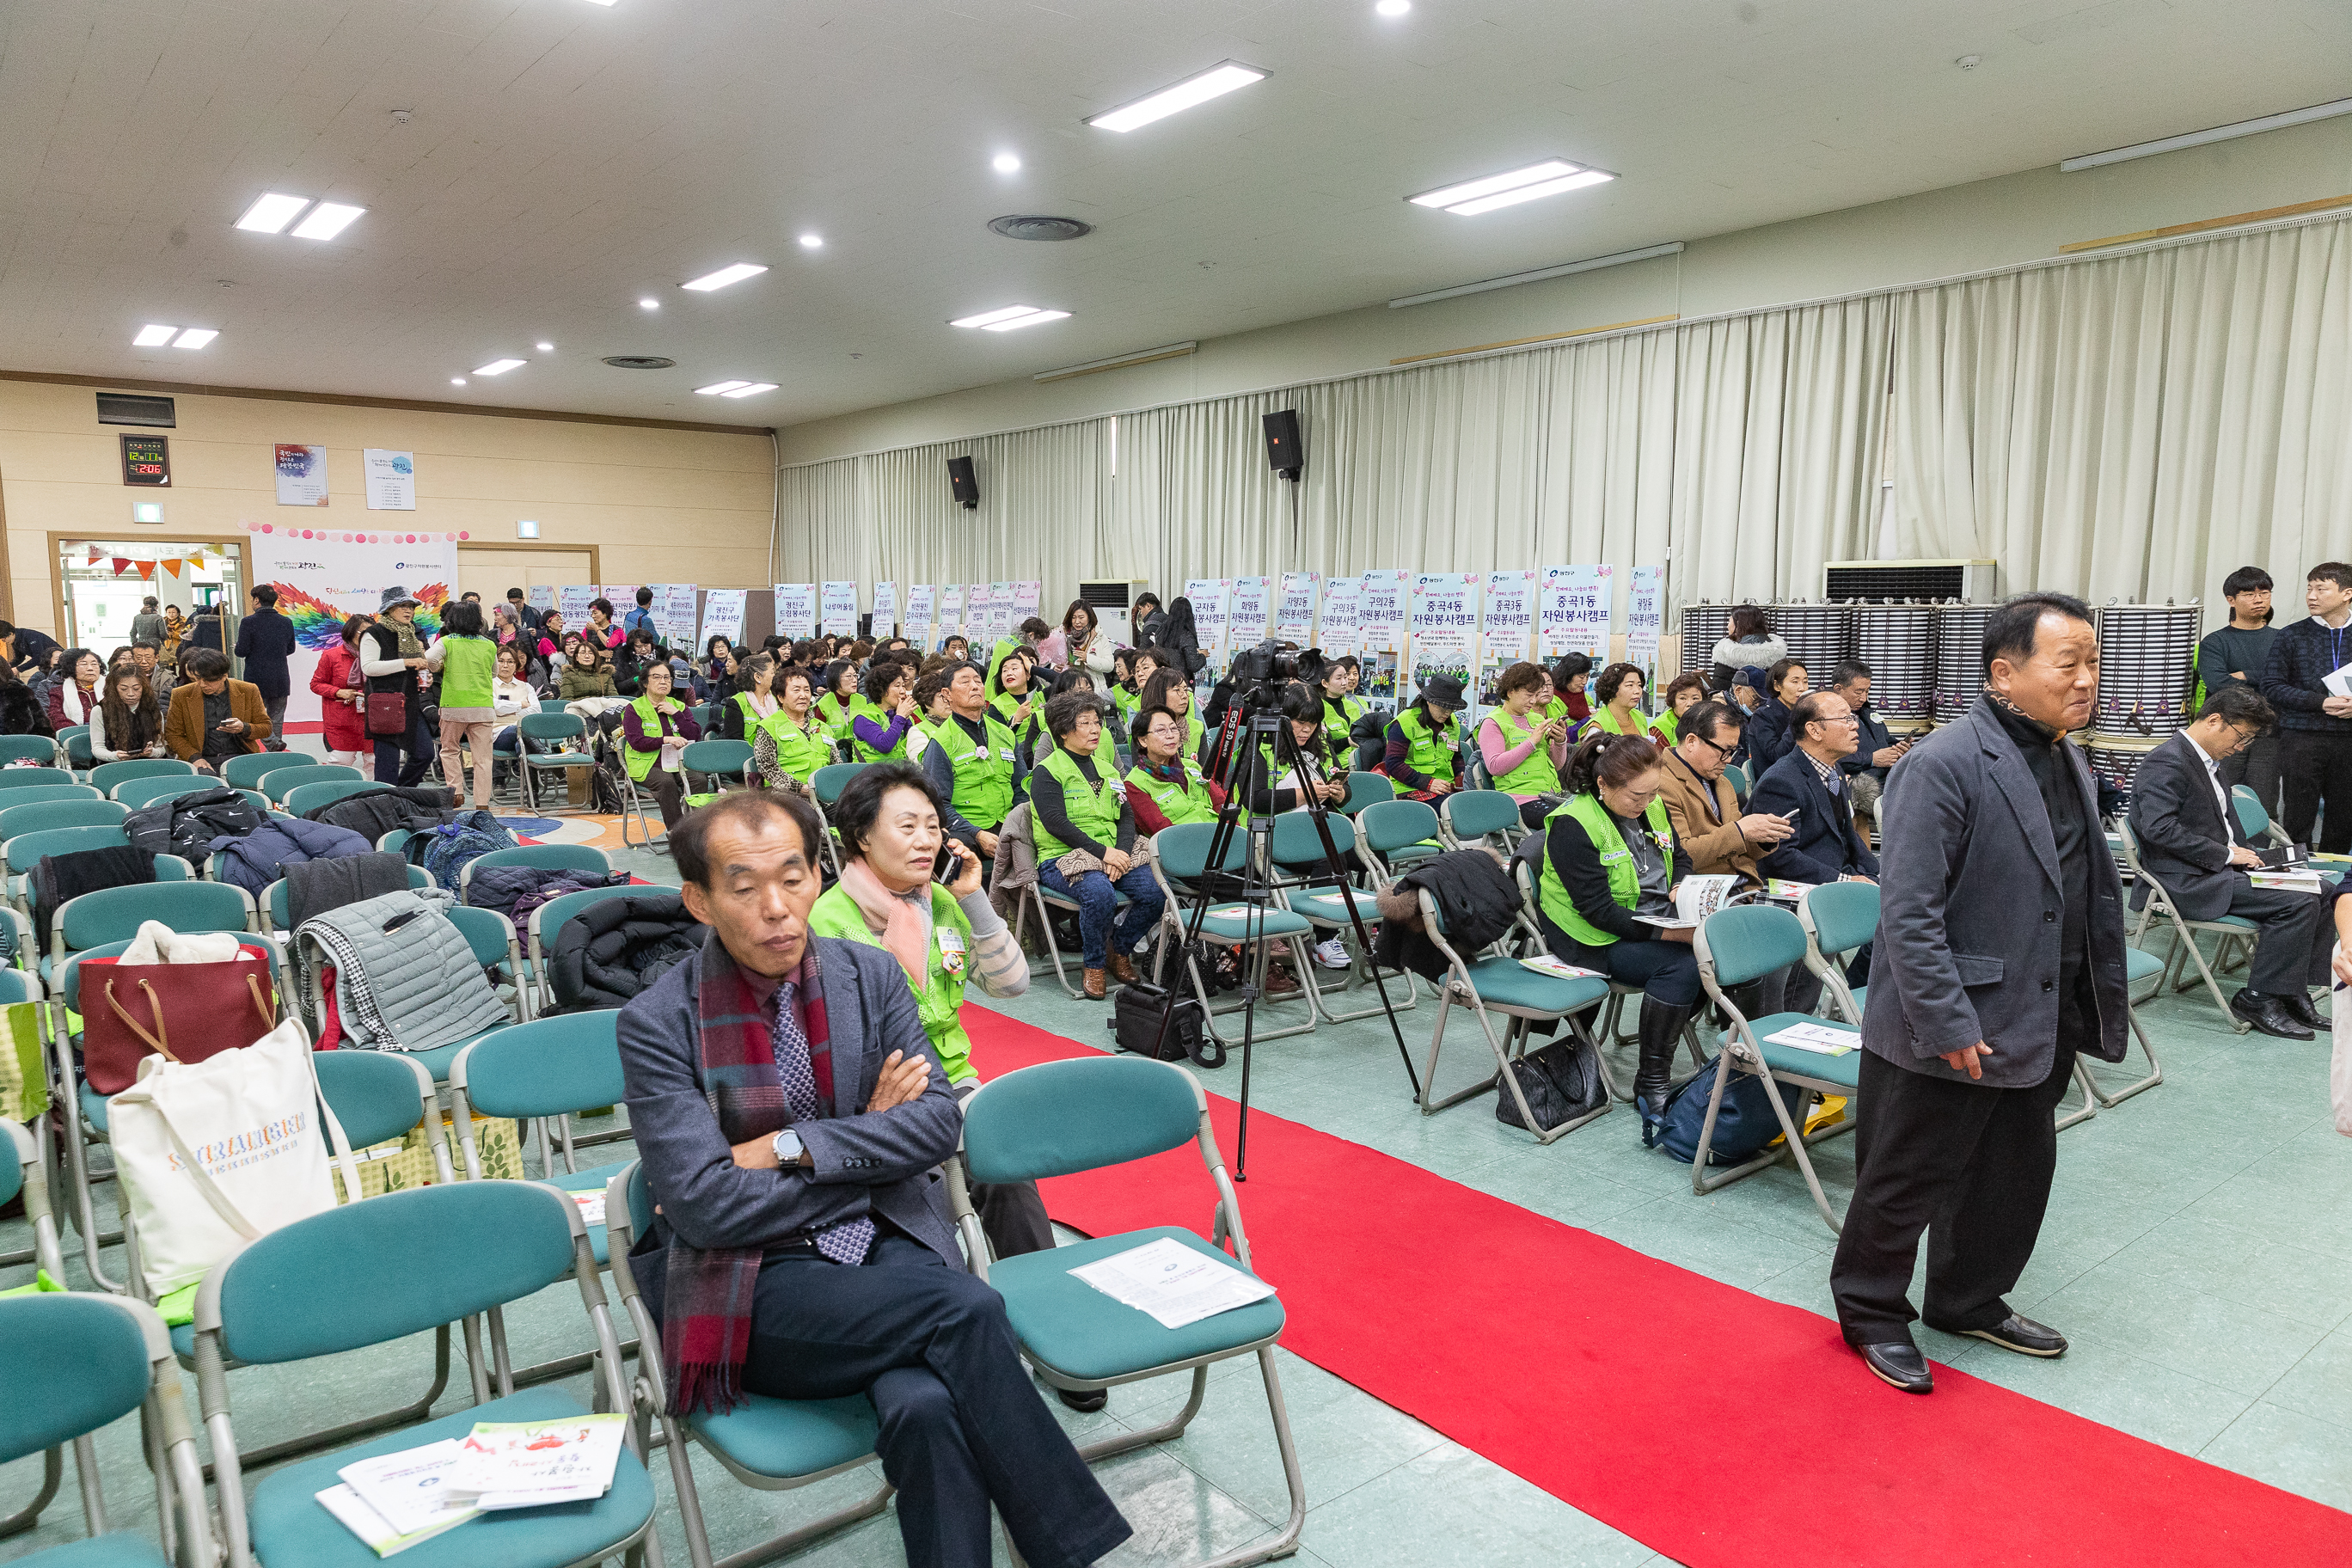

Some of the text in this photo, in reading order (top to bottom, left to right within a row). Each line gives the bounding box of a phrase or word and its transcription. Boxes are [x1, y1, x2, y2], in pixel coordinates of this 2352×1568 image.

[129, 452, 138, 461] 12
[138, 464, 162, 474] 2:06
[298, 561, 318, 570] 광진
[825, 603, 854, 611] 나루어울림
[1241, 601, 1259, 611] 화양동
[1287, 597, 1308, 607] 자양2동
[1369, 597, 1396, 608] 구의2동
[1426, 600, 1463, 612] 중곡4동
[1496, 599, 1522, 611] 중곡3동
[1556, 595, 1596, 608] 중곡1동
[1637, 597, 1653, 610] 광장동
[1195, 603, 1216, 612] 군자동
[1332, 603, 1357, 614] 구의3동
[1193, 613, 1226, 623] 원봉사캠프
[1232, 612, 1266, 623] 자원봉사캠프
[1278, 609, 1313, 619] 자원봉사캠프
[1358, 609, 1404, 621] 자원봉사캠프
[1485, 614, 1530, 625] 자원봉사캠프
[1542, 609, 1609, 622] 자원봉사캠프
[1628, 613, 1659, 626] 자원봉사캠프
[1321, 616, 1357, 627] 자원봉사캠
[1412, 614, 1476, 626] 자원봉사캠프
[1228, 710, 1238, 730] EOS
[1226, 730, 1234, 740] 5D
